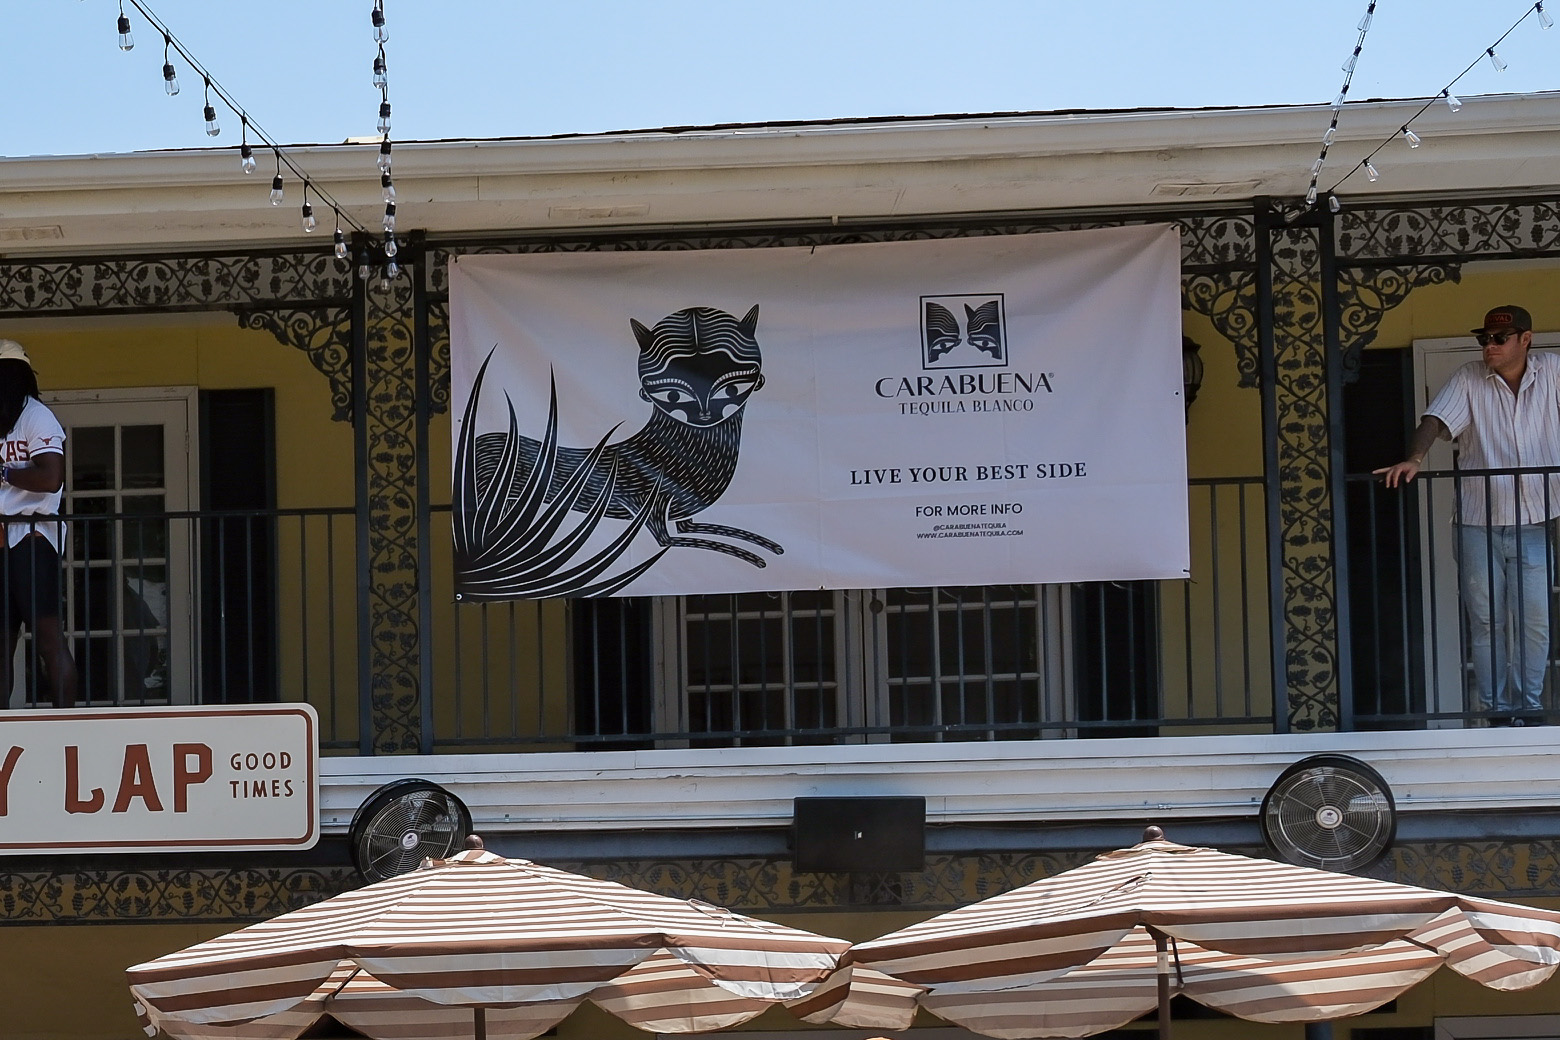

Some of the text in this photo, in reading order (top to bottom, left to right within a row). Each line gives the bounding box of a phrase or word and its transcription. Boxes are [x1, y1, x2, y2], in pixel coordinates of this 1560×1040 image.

[898, 399, 1034, 416] TEQUILA BLANCO
[850, 462, 1087, 485] LIVE YOUR BEST SIDE
[915, 503, 1023, 517] FOR MORE INFO
[916, 530, 1024, 539] WWW.CARABUENATEQUILA.COM
[933, 523, 1007, 531] @CARABUENATEQUILA
[230, 752, 292, 772] GOOD
[64, 743, 213, 814] LAP
[230, 779, 295, 799] TIMES
